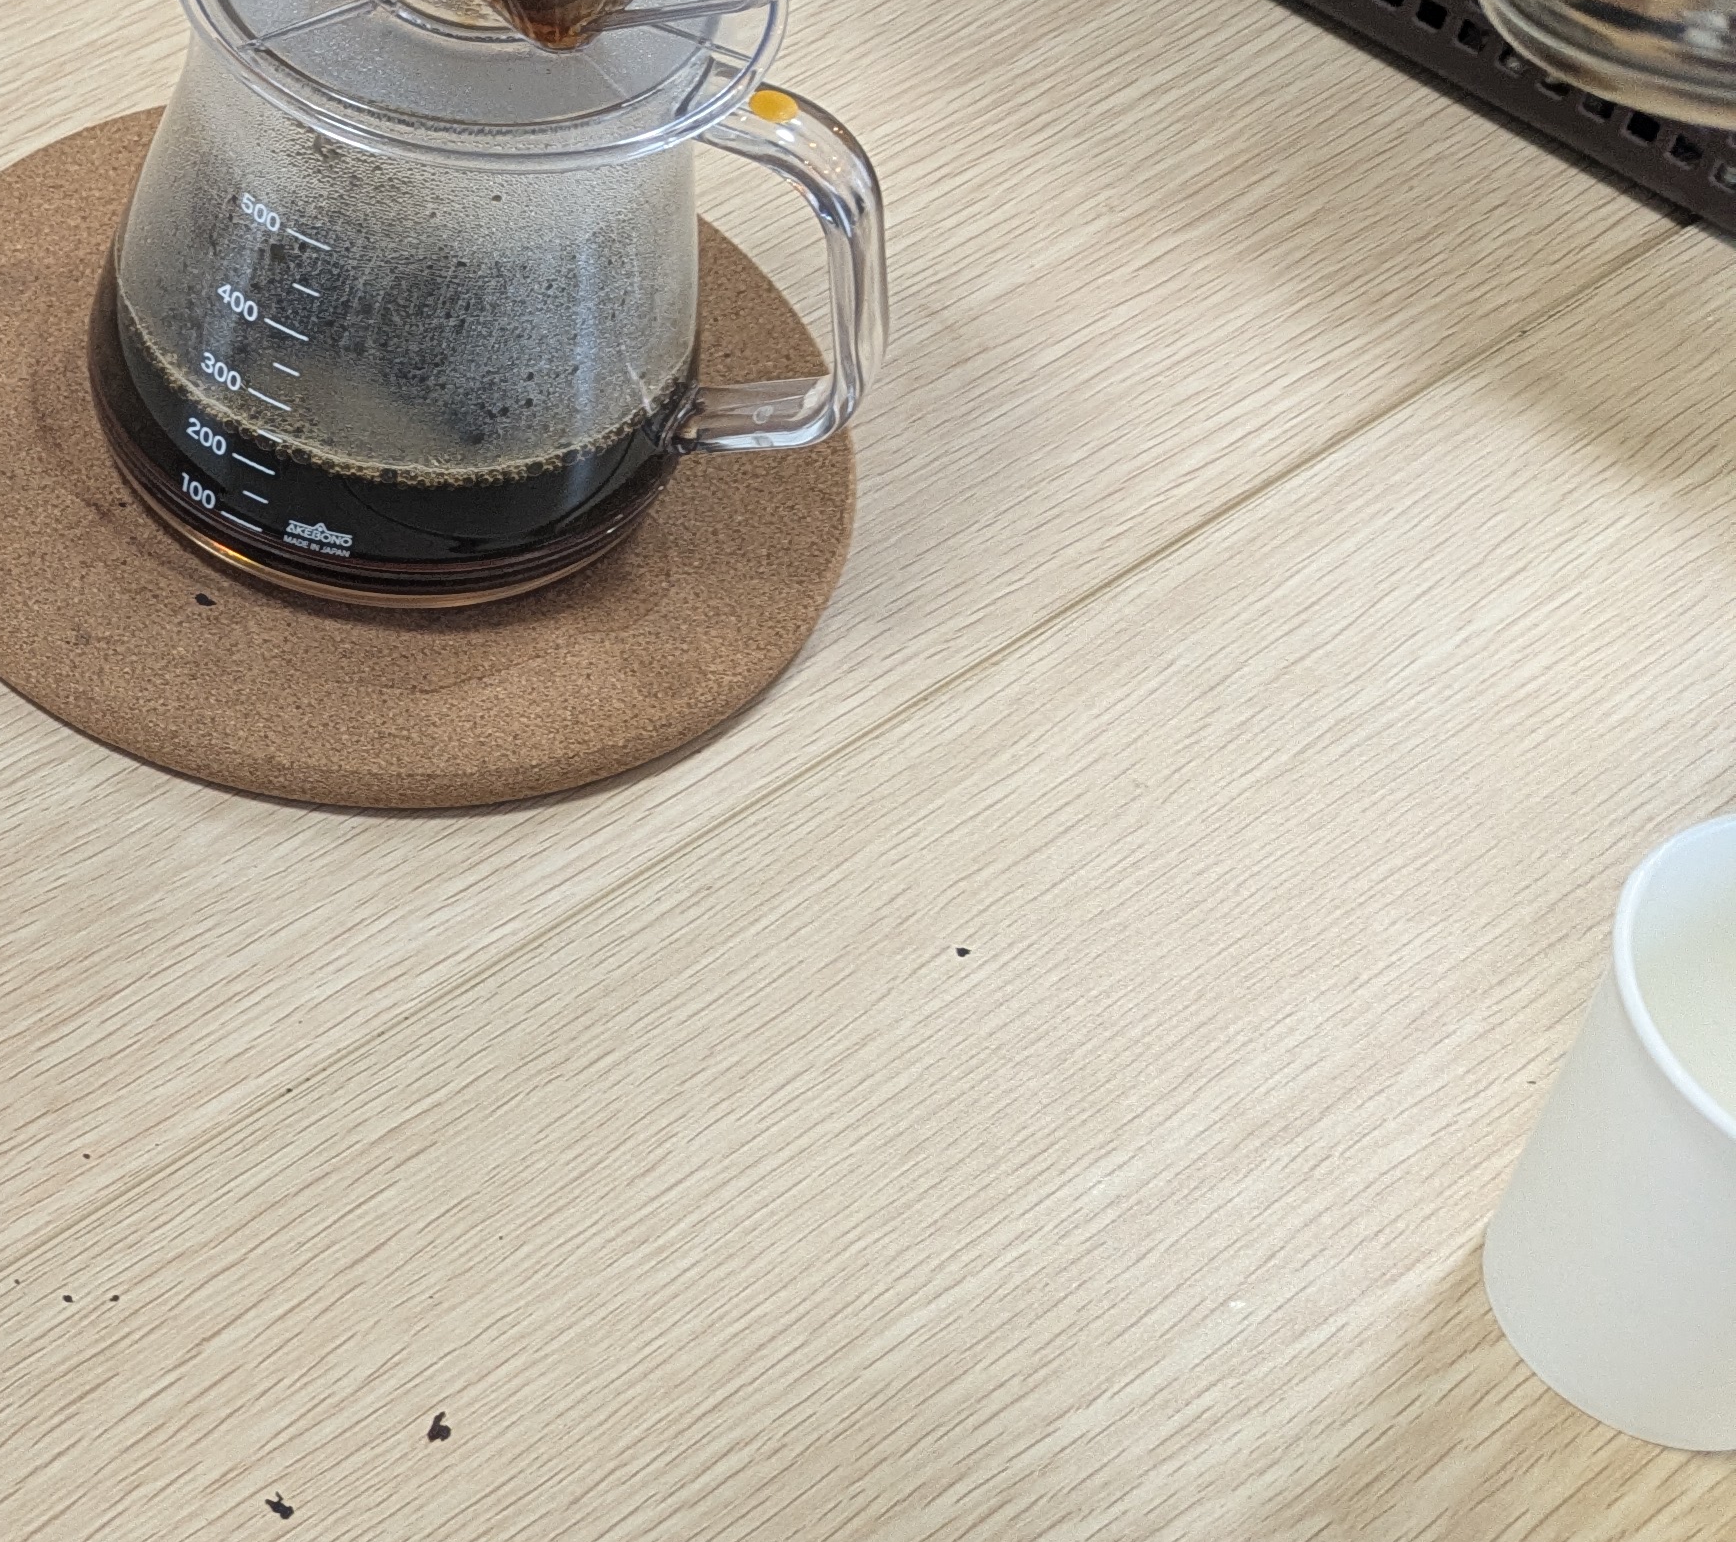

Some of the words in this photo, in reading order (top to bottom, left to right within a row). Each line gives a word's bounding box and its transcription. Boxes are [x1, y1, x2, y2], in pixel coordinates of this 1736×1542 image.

[240, 192, 281, 232] 500
[217, 283, 258, 322] 400
[200, 351, 242, 391] 300
[185, 416, 227, 456] 200
[181, 471, 216, 510] 100
[283, 534, 309, 549] MADE
[309, 542, 321, 552] IN
[320, 545, 351, 558] JAPAN
[285, 522, 353, 547] AKEBONO
